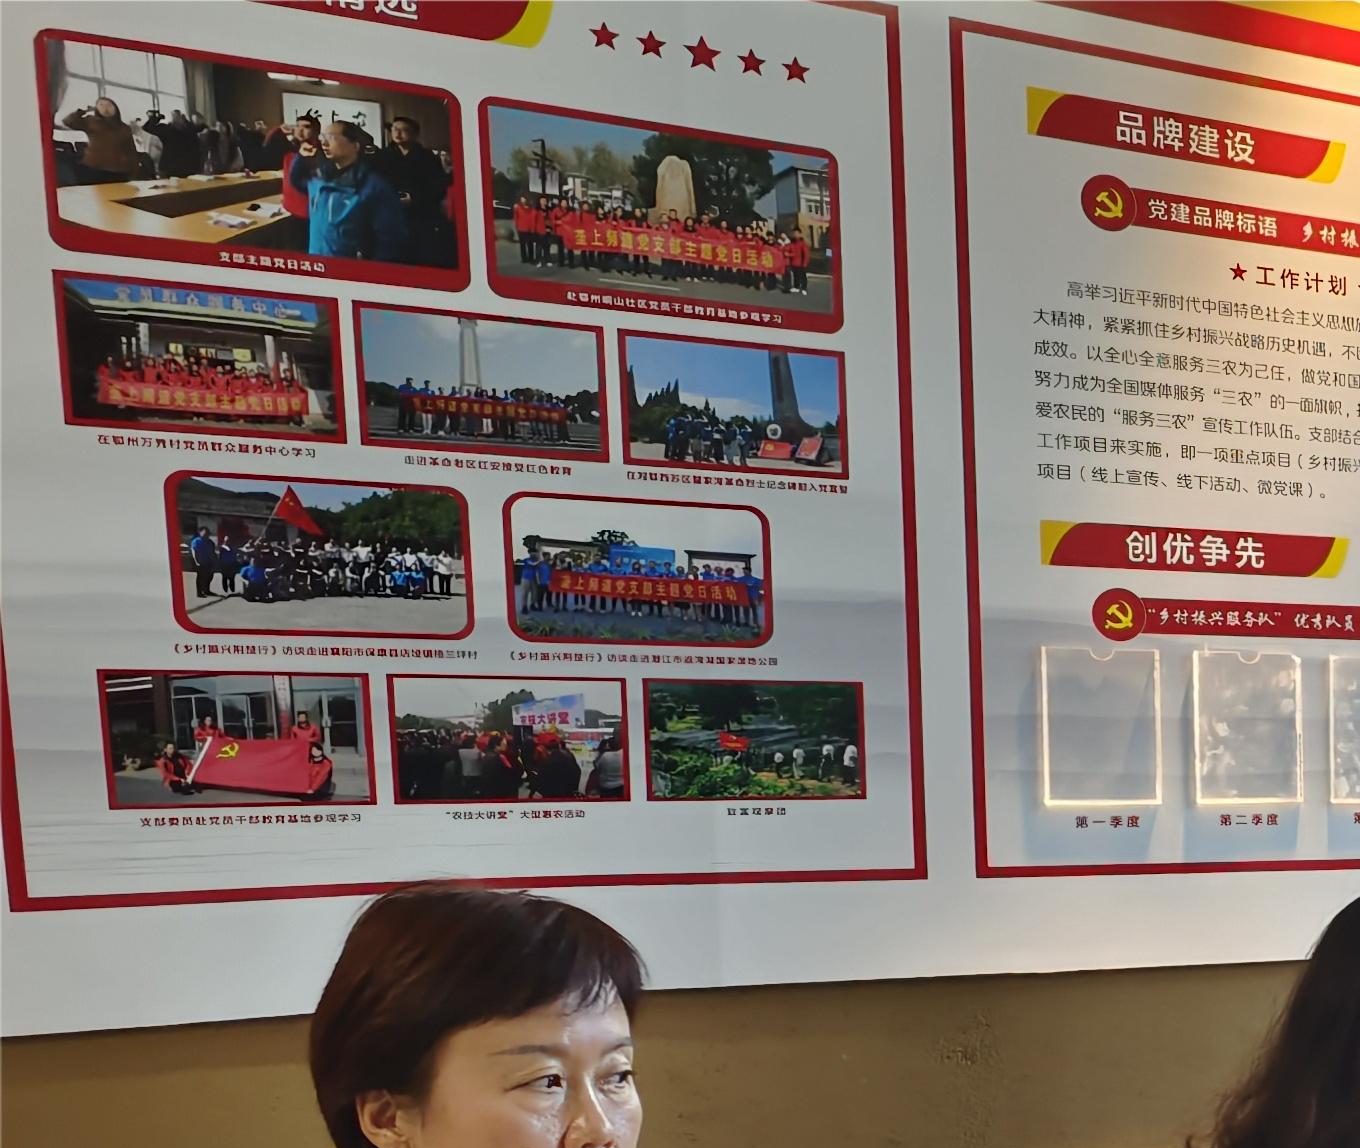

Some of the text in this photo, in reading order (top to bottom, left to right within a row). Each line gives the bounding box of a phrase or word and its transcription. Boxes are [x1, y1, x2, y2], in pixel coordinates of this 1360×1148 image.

[1115, 110, 1256, 166] 品牌建设
[1147, 198, 1278, 239] 党建品牌标语
[1255, 264, 1348, 298] 工作计划
[1125, 530, 1266, 570] 创优争先
[1075, 814, 1141, 829] 第一季度
[1219, 812, 1279, 828] 第二季度
